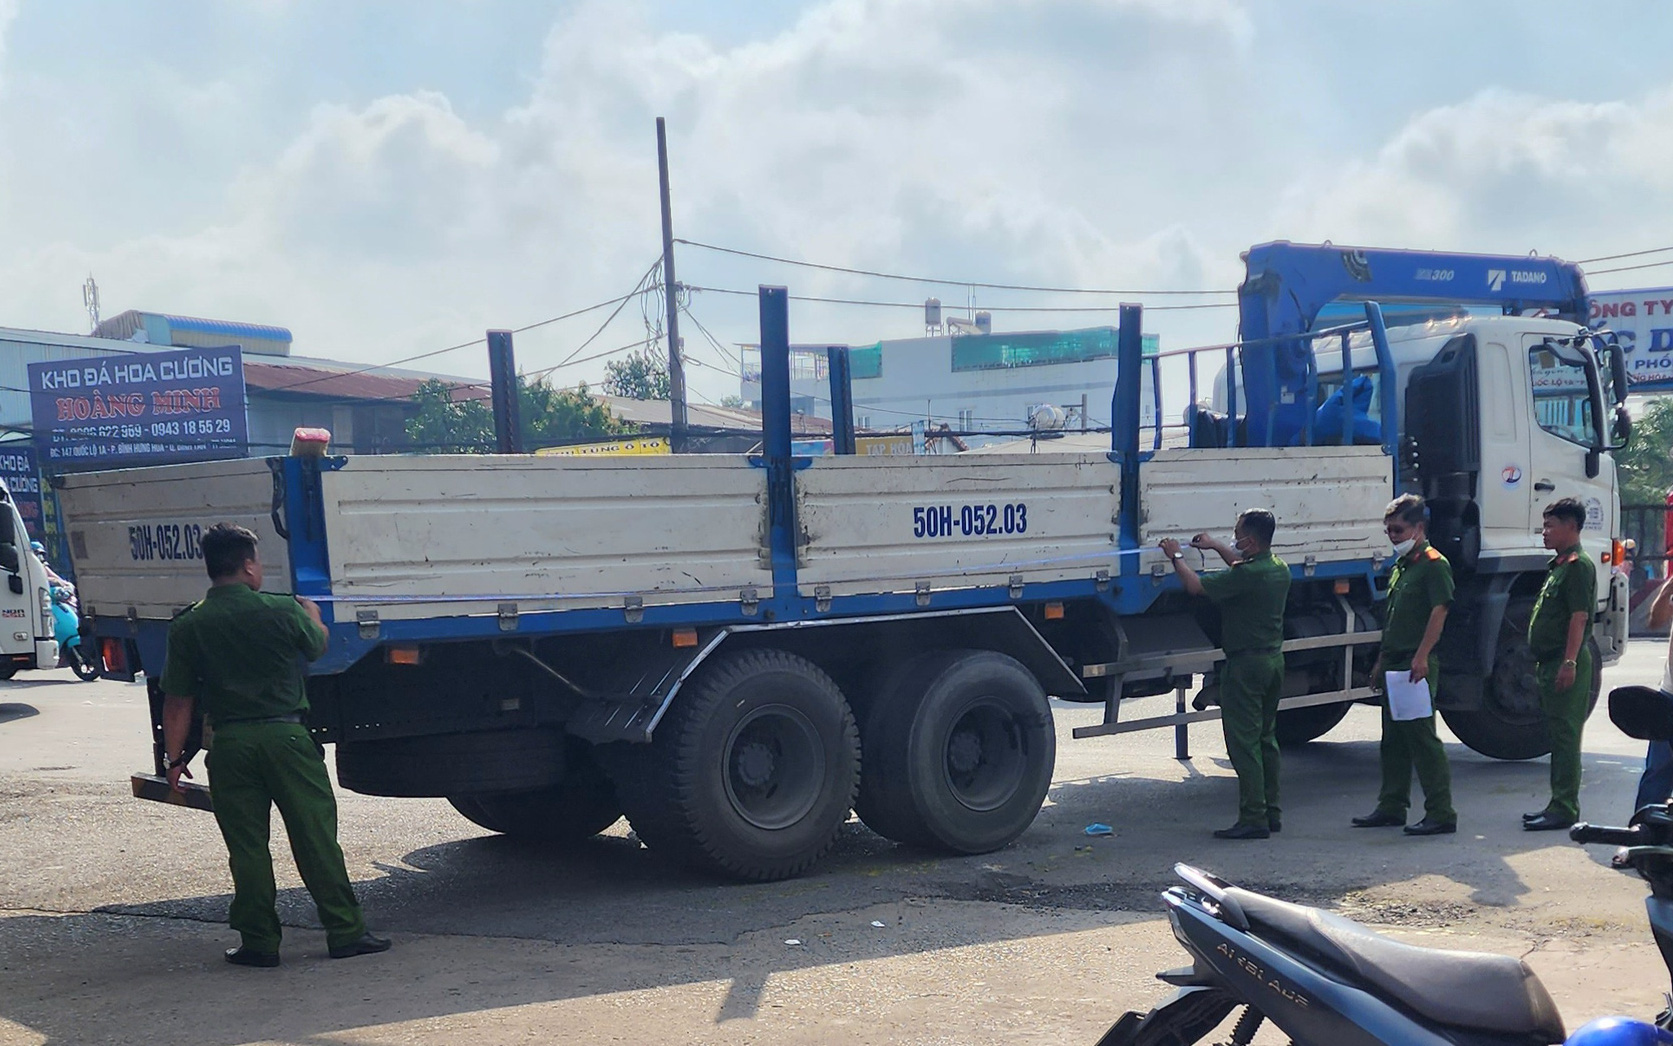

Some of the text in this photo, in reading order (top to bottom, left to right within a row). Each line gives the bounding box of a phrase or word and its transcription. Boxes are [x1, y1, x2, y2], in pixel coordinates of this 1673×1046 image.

[1511, 270, 1547, 284] TADANO
[1589, 299, 1673, 318] ÔNG TY
[42, 356, 233, 389] KHO ĐÁ HOA CƯƠNG
[1635, 353, 1673, 370] PHỐ
[56, 387, 221, 421] HOÀNG MINH
[151, 421, 180, 437] 0943
[183, 421, 196, 435] 18
[199, 419, 213, 434] 55
[216, 418, 231, 433] 29
[913, 503, 1027, 538] 50H-052.03
[128, 524, 204, 561] 50H-052.03
